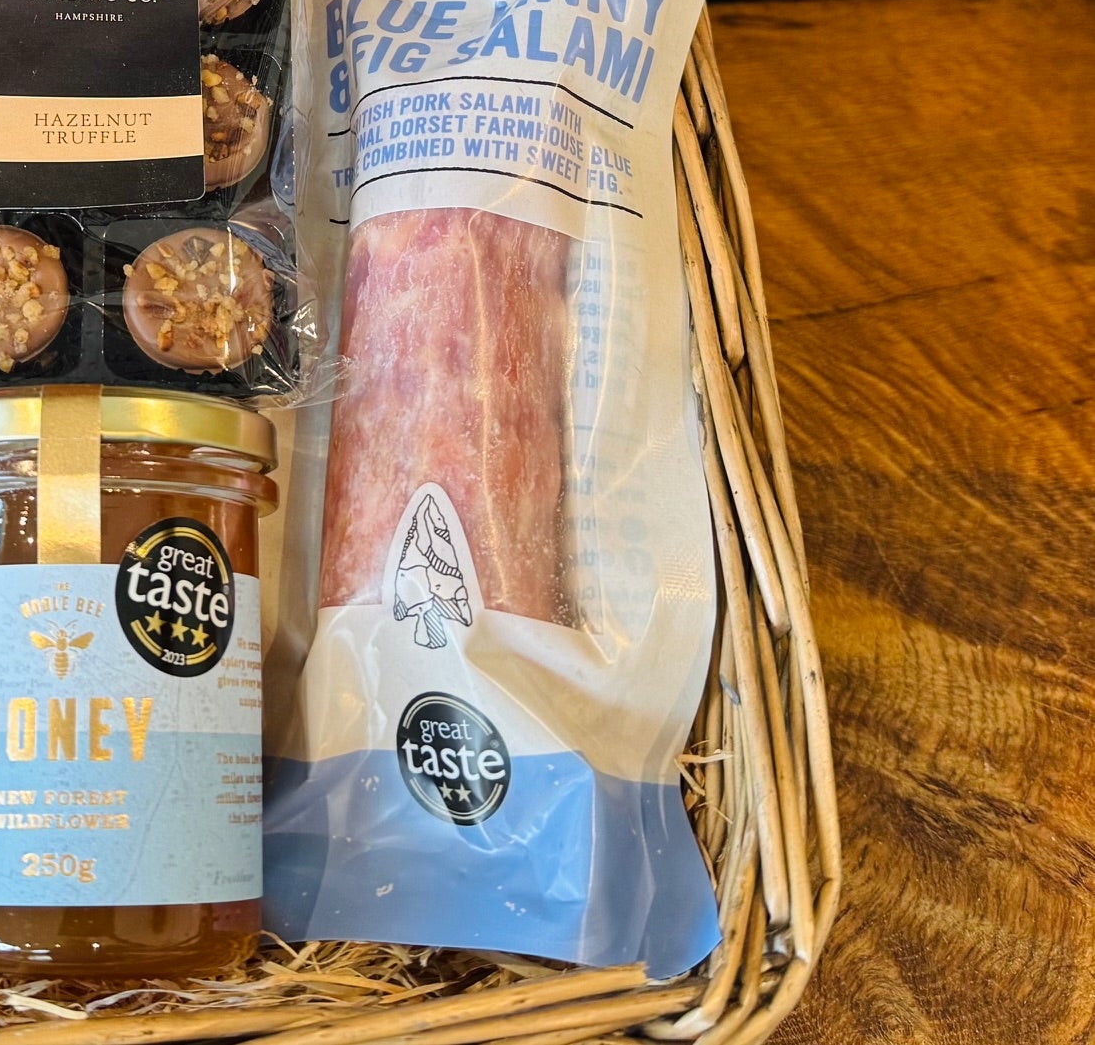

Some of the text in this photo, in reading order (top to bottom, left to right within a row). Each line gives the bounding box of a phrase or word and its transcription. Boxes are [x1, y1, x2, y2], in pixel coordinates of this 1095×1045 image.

[55, 12, 124, 23] HAMPSHIRE
[329, 9, 655, 113] & FIG SALAMI
[34, 112, 152, 128] HAZELNUT
[400, 92, 452, 115] PORK
[459, 92, 540, 117] SALAMI
[549, 100, 582, 136] WITH
[42, 130, 137, 145] TRUFFLE
[389, 115, 468, 140] DORSET
[475, 115, 584, 162] FARMHOUSE
[591, 145, 633, 178] BLUE
[362, 137, 624, 195] COMBINED WITH SWEET FIG.
[160, 545, 214, 580] great
[76, 597, 104, 618] BEE
[126, 561, 230, 628] taste
[162, 649, 186, 667] 2023
[420, 719, 472, 743] great
[401, 738, 506, 781] taste
[44, 790, 128, 806] FOREST
[21, 852, 97, 884] 250g
